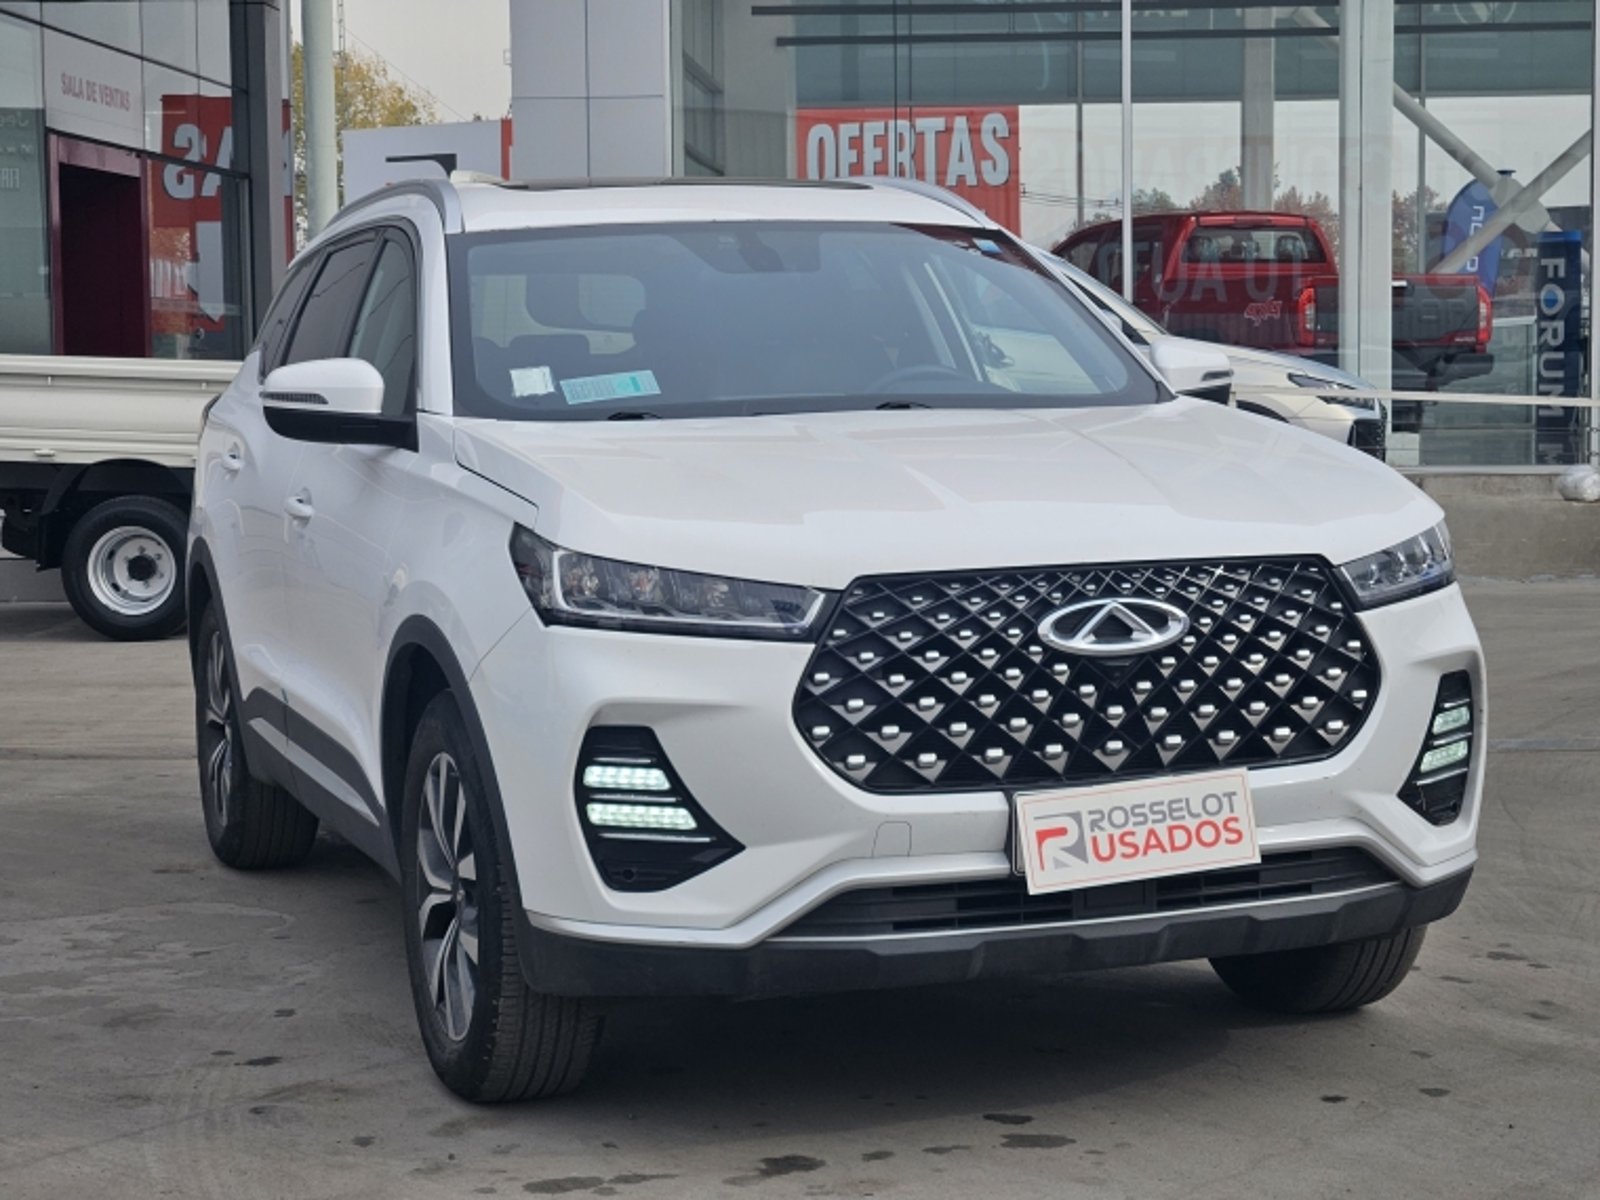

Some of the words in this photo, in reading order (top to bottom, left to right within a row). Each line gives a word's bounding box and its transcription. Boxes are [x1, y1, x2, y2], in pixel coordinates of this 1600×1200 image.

[86, 79, 97, 103] DE
[806, 113, 1010, 187] OFERTAS
[1538, 257, 1565, 417] FORUM
[1088, 791, 1238, 833] ROSSELOT
[1091, 816, 1244, 863] USADOS
